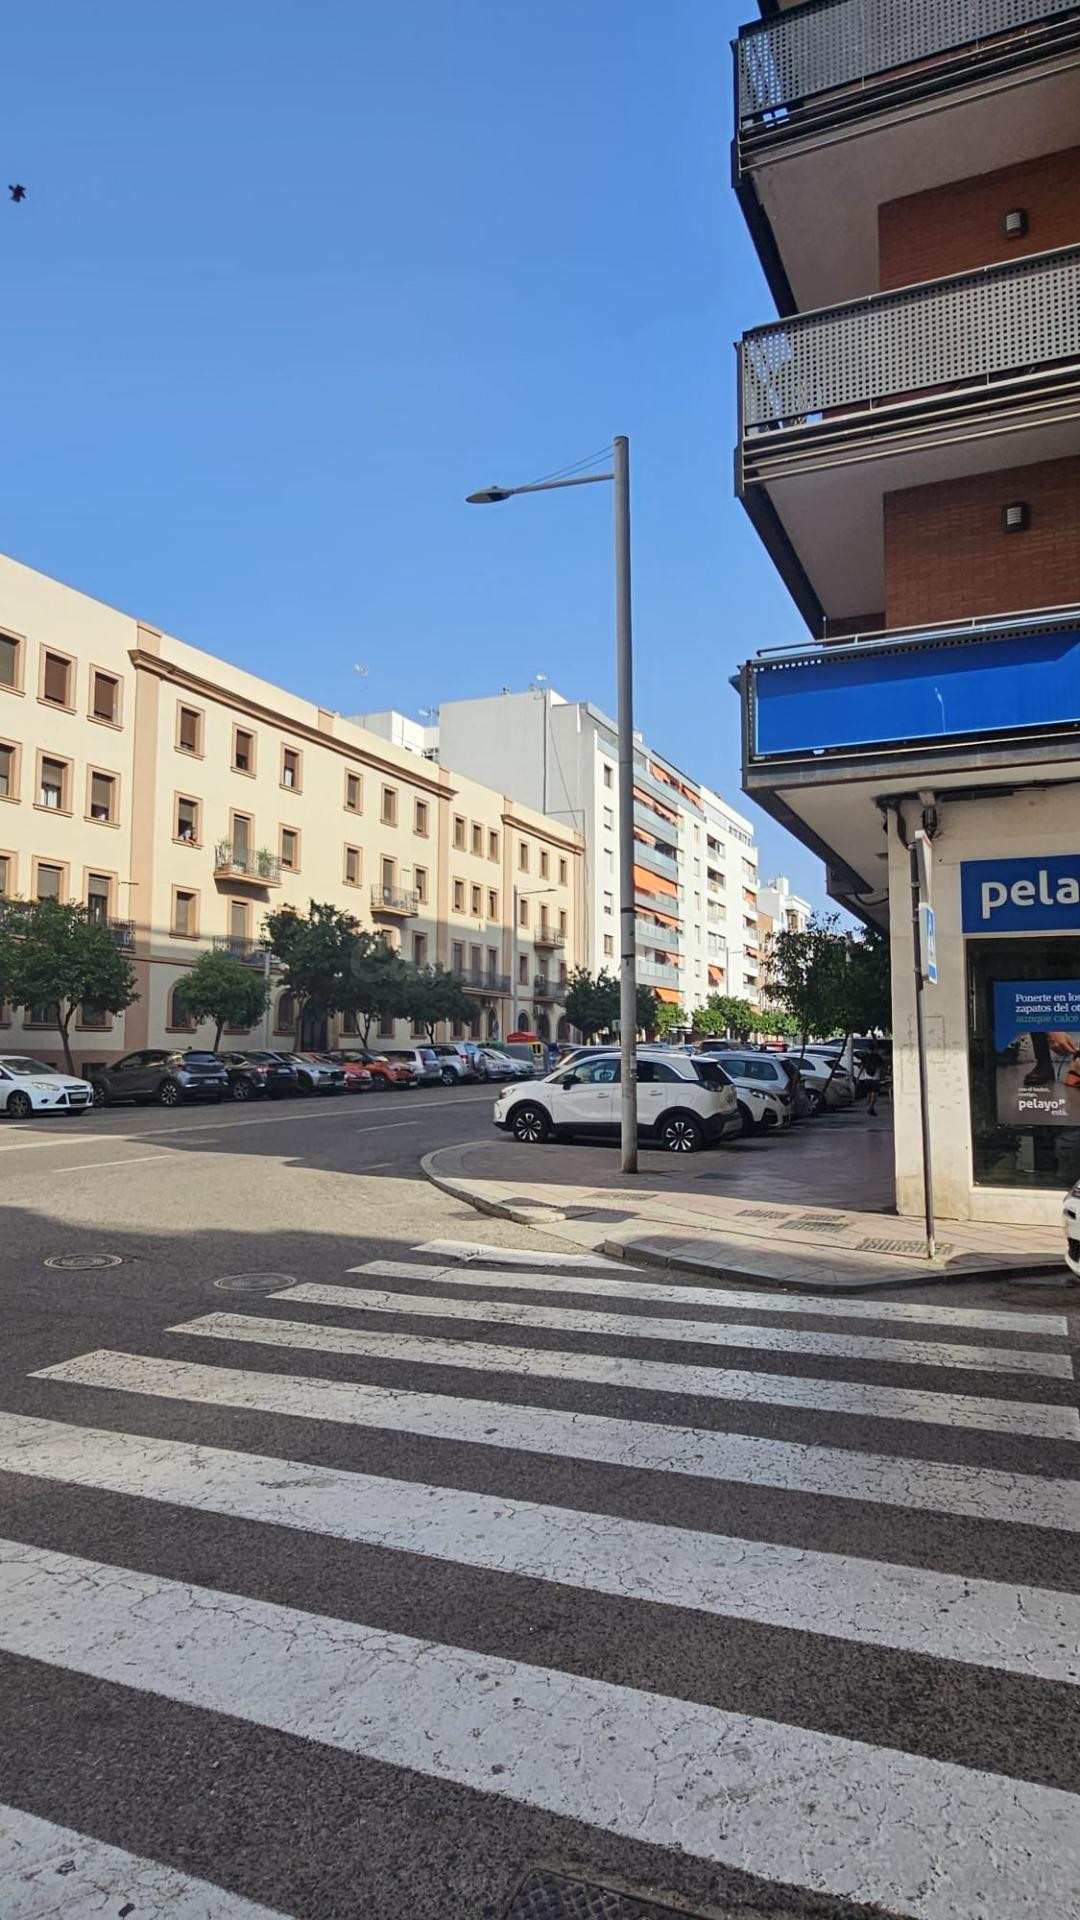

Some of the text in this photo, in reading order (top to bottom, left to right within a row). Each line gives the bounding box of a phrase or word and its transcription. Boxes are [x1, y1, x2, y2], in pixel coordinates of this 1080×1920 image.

[982, 870, 1080, 919] pela
[1016, 994, 1051, 1002] Ponerte
[1016, 1005, 1052, 1014] zapatos
[1053, 1003, 1069, 1012] del
[1019, 1099, 1058, 1111] pelayo
